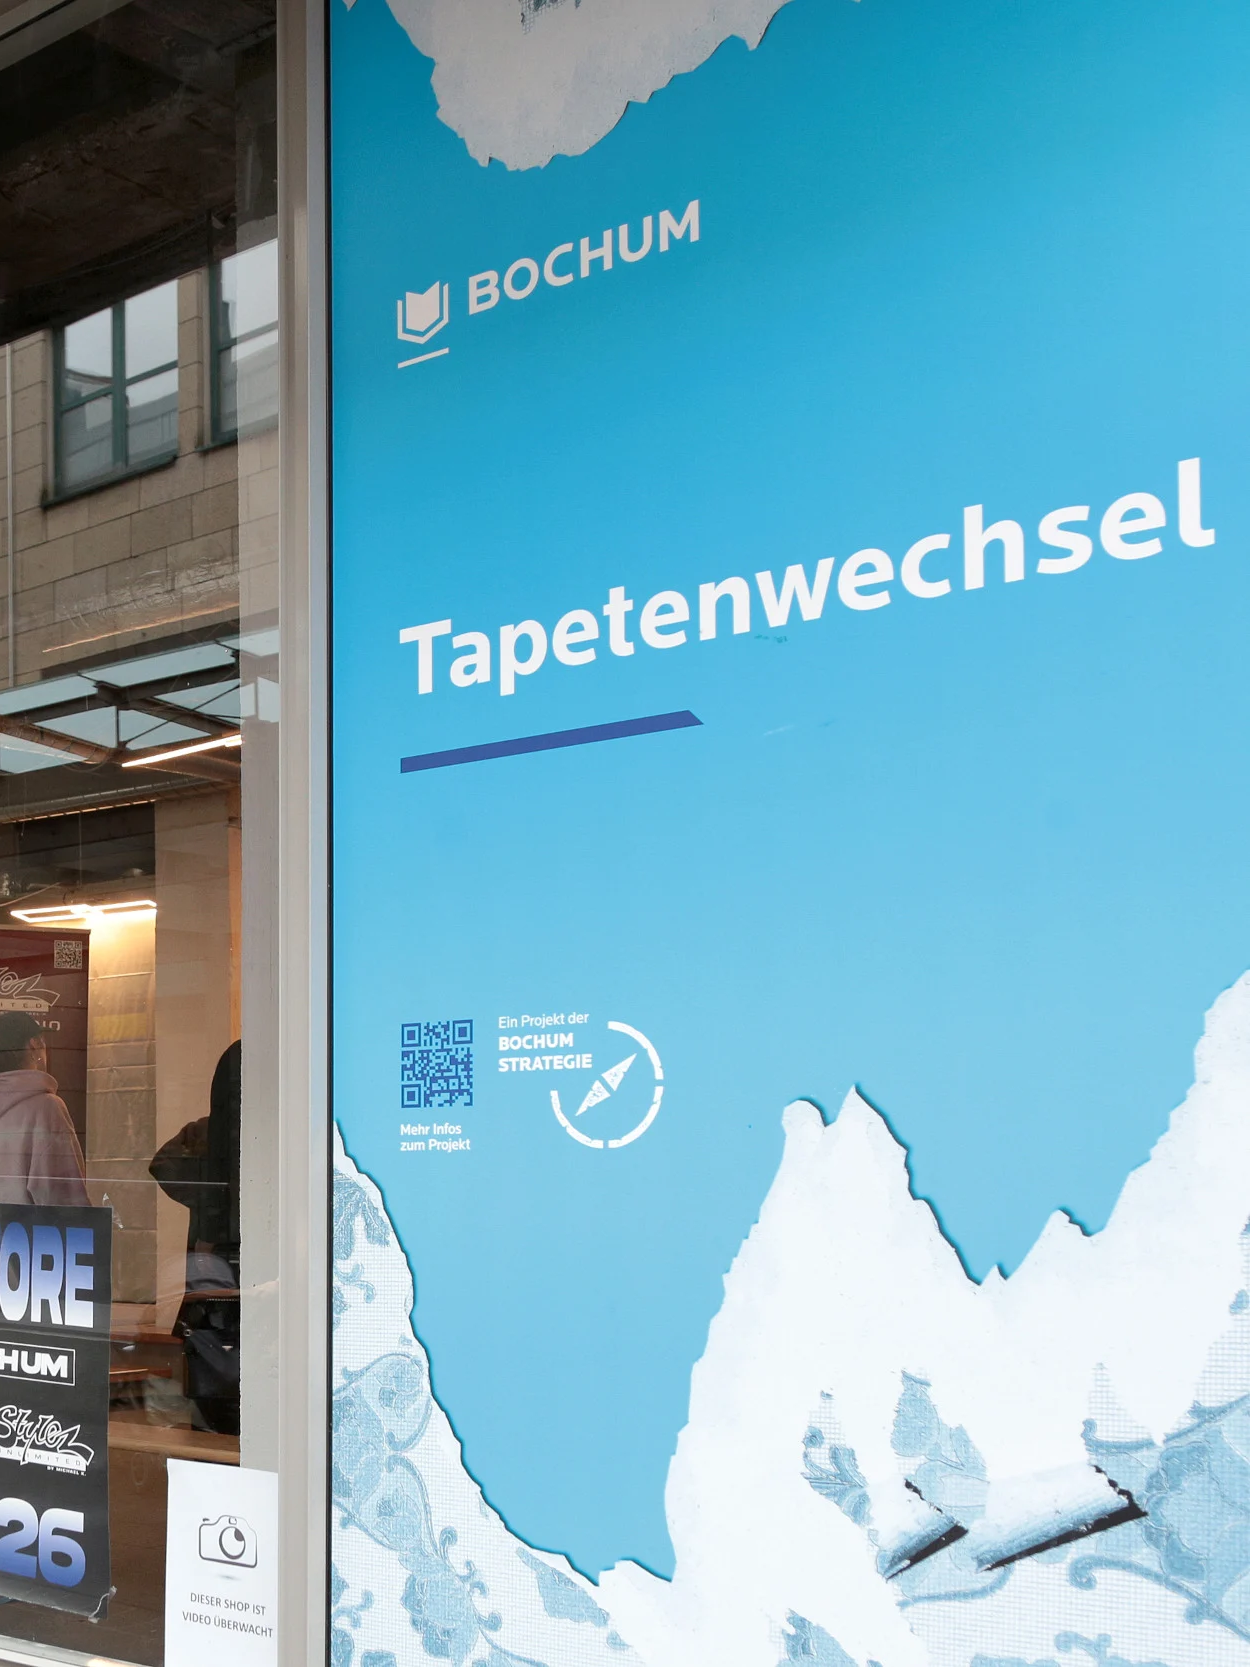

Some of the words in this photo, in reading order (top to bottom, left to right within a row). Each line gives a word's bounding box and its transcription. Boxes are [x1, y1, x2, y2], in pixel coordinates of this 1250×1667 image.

[468, 199, 701, 315] BOCHUM
[399, 457, 1216, 697] Tapetenwechsel
[498, 1015, 519, 1029] Ein
[521, 1013, 566, 1029] Projekt
[568, 1012, 590, 1025] der
[498, 1033, 575, 1051] BOCHUM
[498, 1054, 593, 1073] STRATEGIE
[400, 1124, 430, 1136] Mehr
[433, 1123, 462, 1135] Infos
[400, 1142, 426, 1151] zum
[428, 1138, 471, 1153] Projekt
[190, 1592, 222, 1608] DIESER
[224, 1599, 250, 1613] SHOP
[252, 1604, 266, 1616] IST
[182, 1610, 211, 1626] VIDEO
[213, 1615, 273, 1639] ÜBERWACHT
